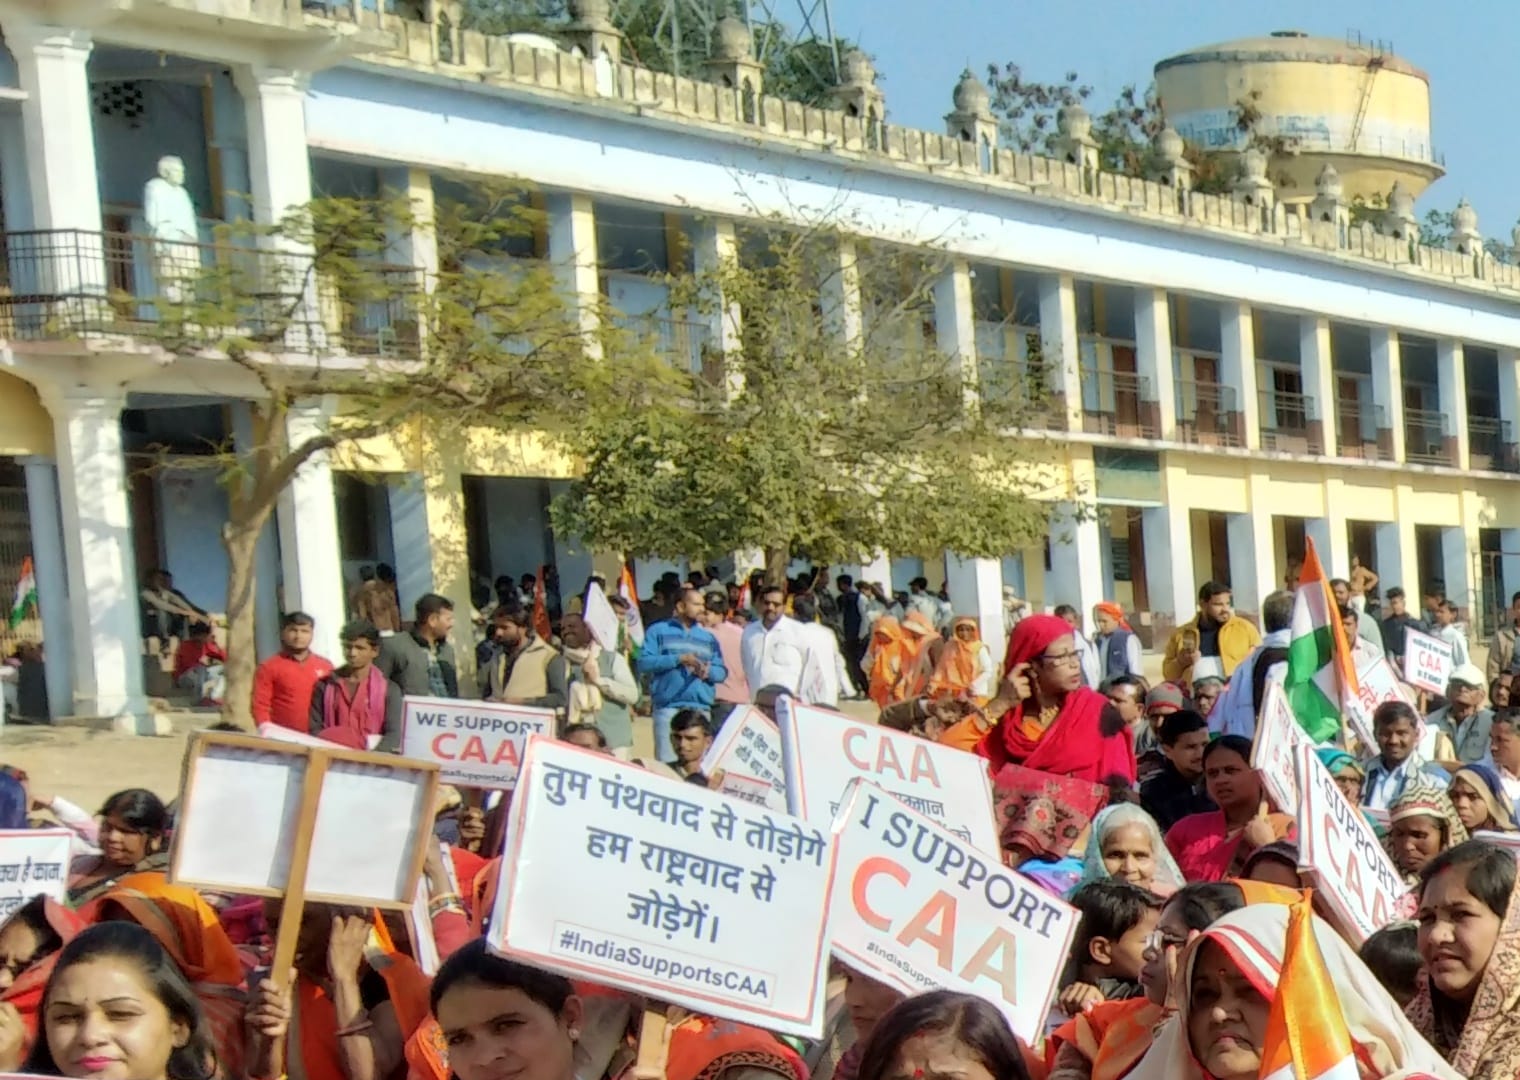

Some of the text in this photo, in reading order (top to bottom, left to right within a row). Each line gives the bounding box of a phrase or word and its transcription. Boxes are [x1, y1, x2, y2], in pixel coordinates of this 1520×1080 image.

[1419, 650, 1442, 673] CAA
[416, 711, 544, 735] WE SUPPORT
[432, 732, 519, 767] CAA
[842, 727, 941, 788] CAA
[542, 762, 591, 806] तुम
[599, 774, 703, 832] पंथवाद
[711, 803, 738, 841] से
[745, 814, 828, 867] तोड़ोगे
[1313, 759, 1322, 789] I
[1324, 779, 1400, 900] SUPPORT
[586, 825, 777, 902] हम राष्ट्रवाद से
[859, 794, 1063, 940] I SUPPORT
[1324, 812, 1390, 929] CAA
[559, 929, 769, 998] #IndiaSupportsCAA
[851, 855, 1018, 1007] CAA
